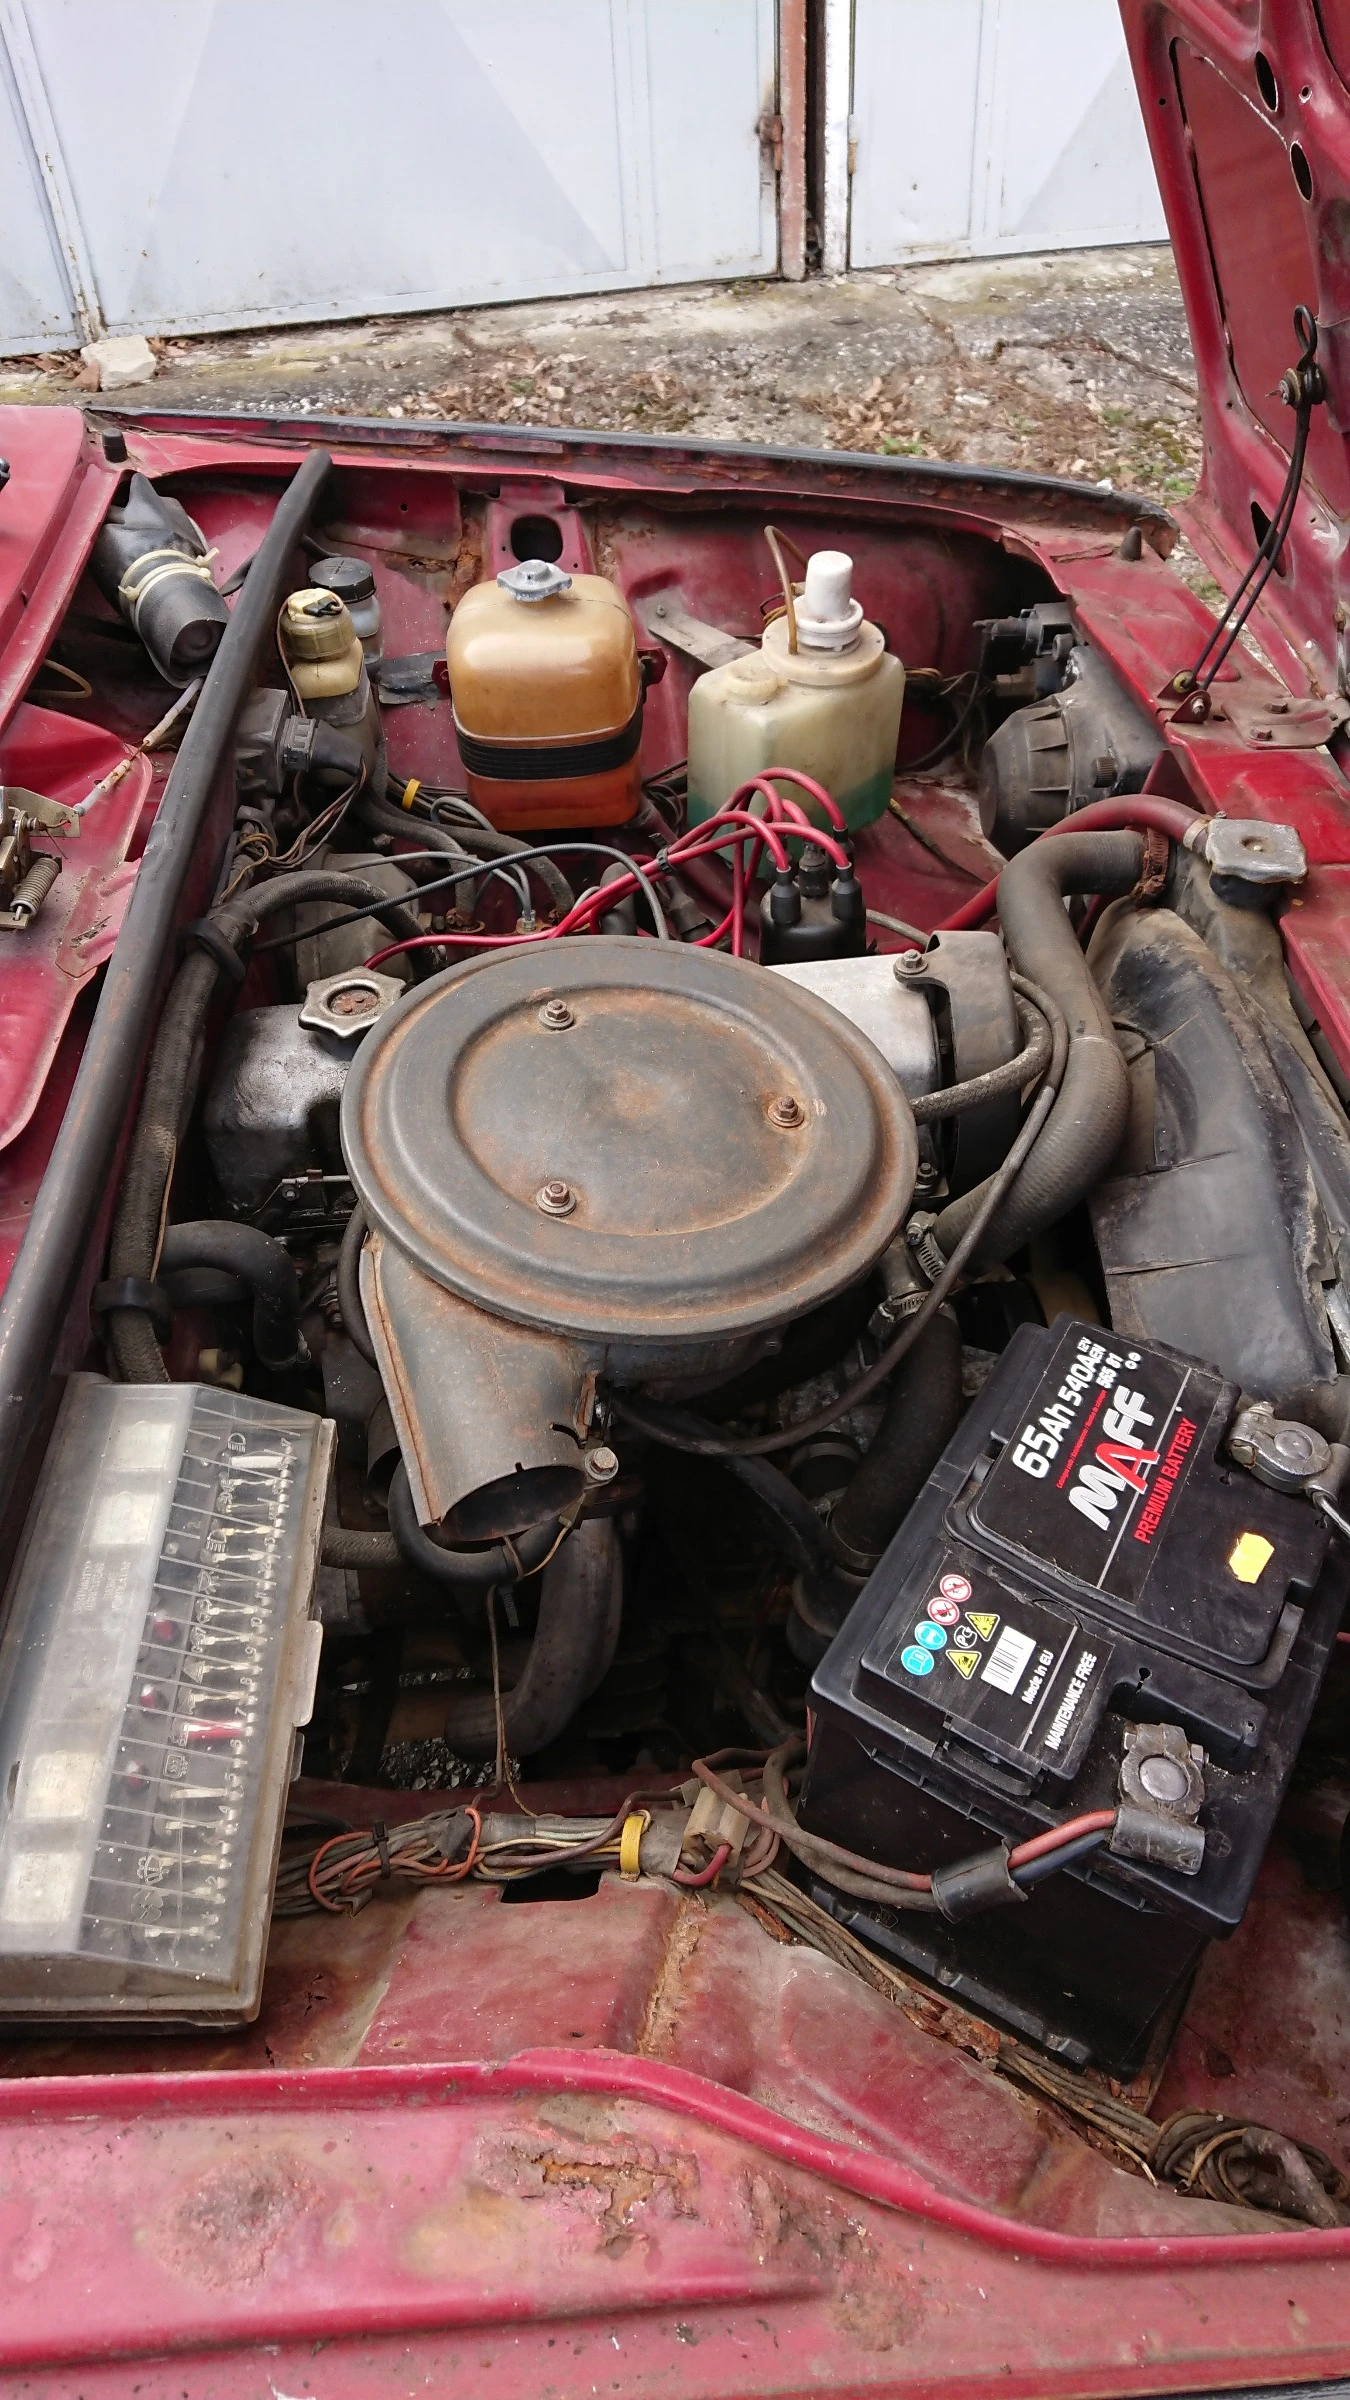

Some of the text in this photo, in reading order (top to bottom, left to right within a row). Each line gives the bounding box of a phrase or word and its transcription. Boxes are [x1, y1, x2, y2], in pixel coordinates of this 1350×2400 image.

[1077, 1336, 1092, 1352] 12V
[1096, 1353, 1124, 1389] 565 81
[1012, 1403, 1077, 1479] 65Ah
[1068, 1385, 1161, 1531] MAFF
[1133, 1416, 1198, 1544] PREMIUM BATTERY
[1021, 1675, 1043, 1705] Made
[1040, 1649, 1054, 1666] EU
[1044, 1650, 1098, 1750] MAINTENANCE FREE
